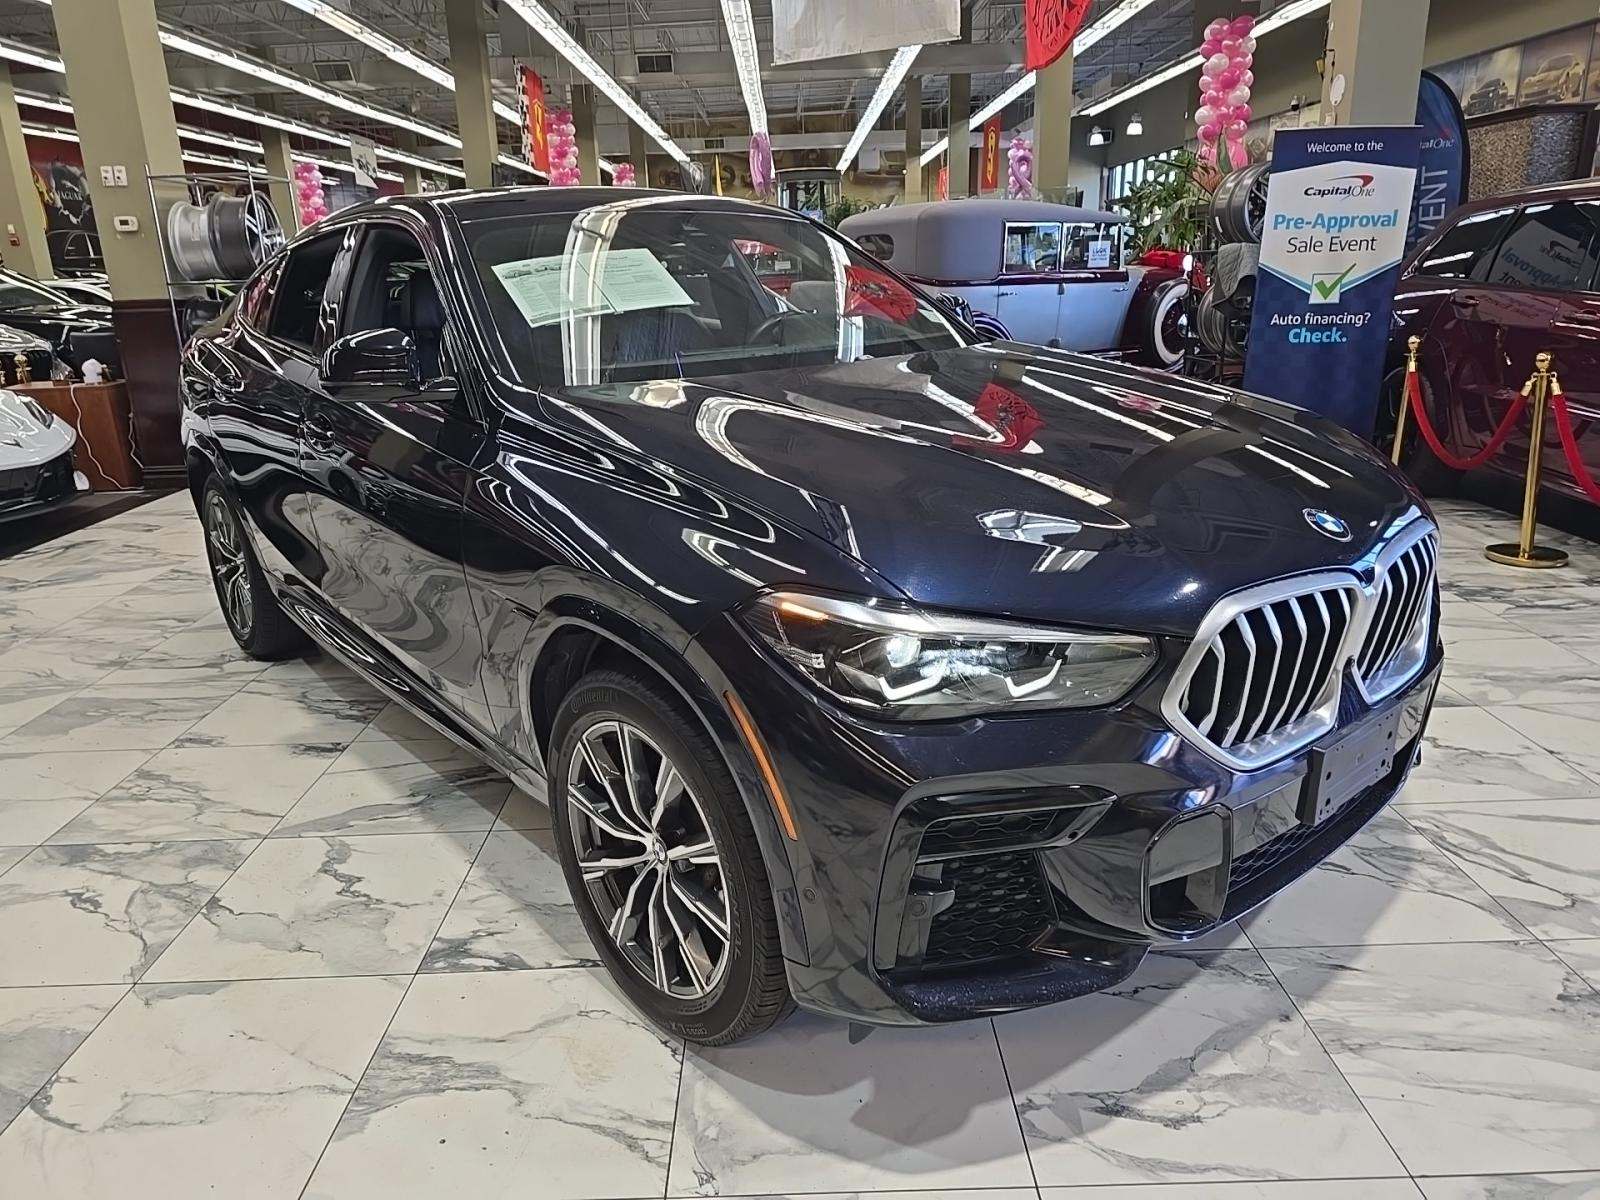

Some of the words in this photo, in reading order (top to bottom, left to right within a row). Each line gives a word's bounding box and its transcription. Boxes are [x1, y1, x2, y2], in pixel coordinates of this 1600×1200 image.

[1307, 142, 1351, 153] Welcome
[1354, 142, 1365, 151] to
[1367, 141, 1384, 150] the
[1418, 165, 1448, 243] VENT
[1273, 209, 1399, 233] Pre-Approval
[1286, 235, 1323, 253] Sale
[1328, 235, 1377, 252] Event
[1270, 313, 1300, 325] Auto
[1304, 312, 1371, 327] financing?
[1288, 327, 1347, 343] Check.
